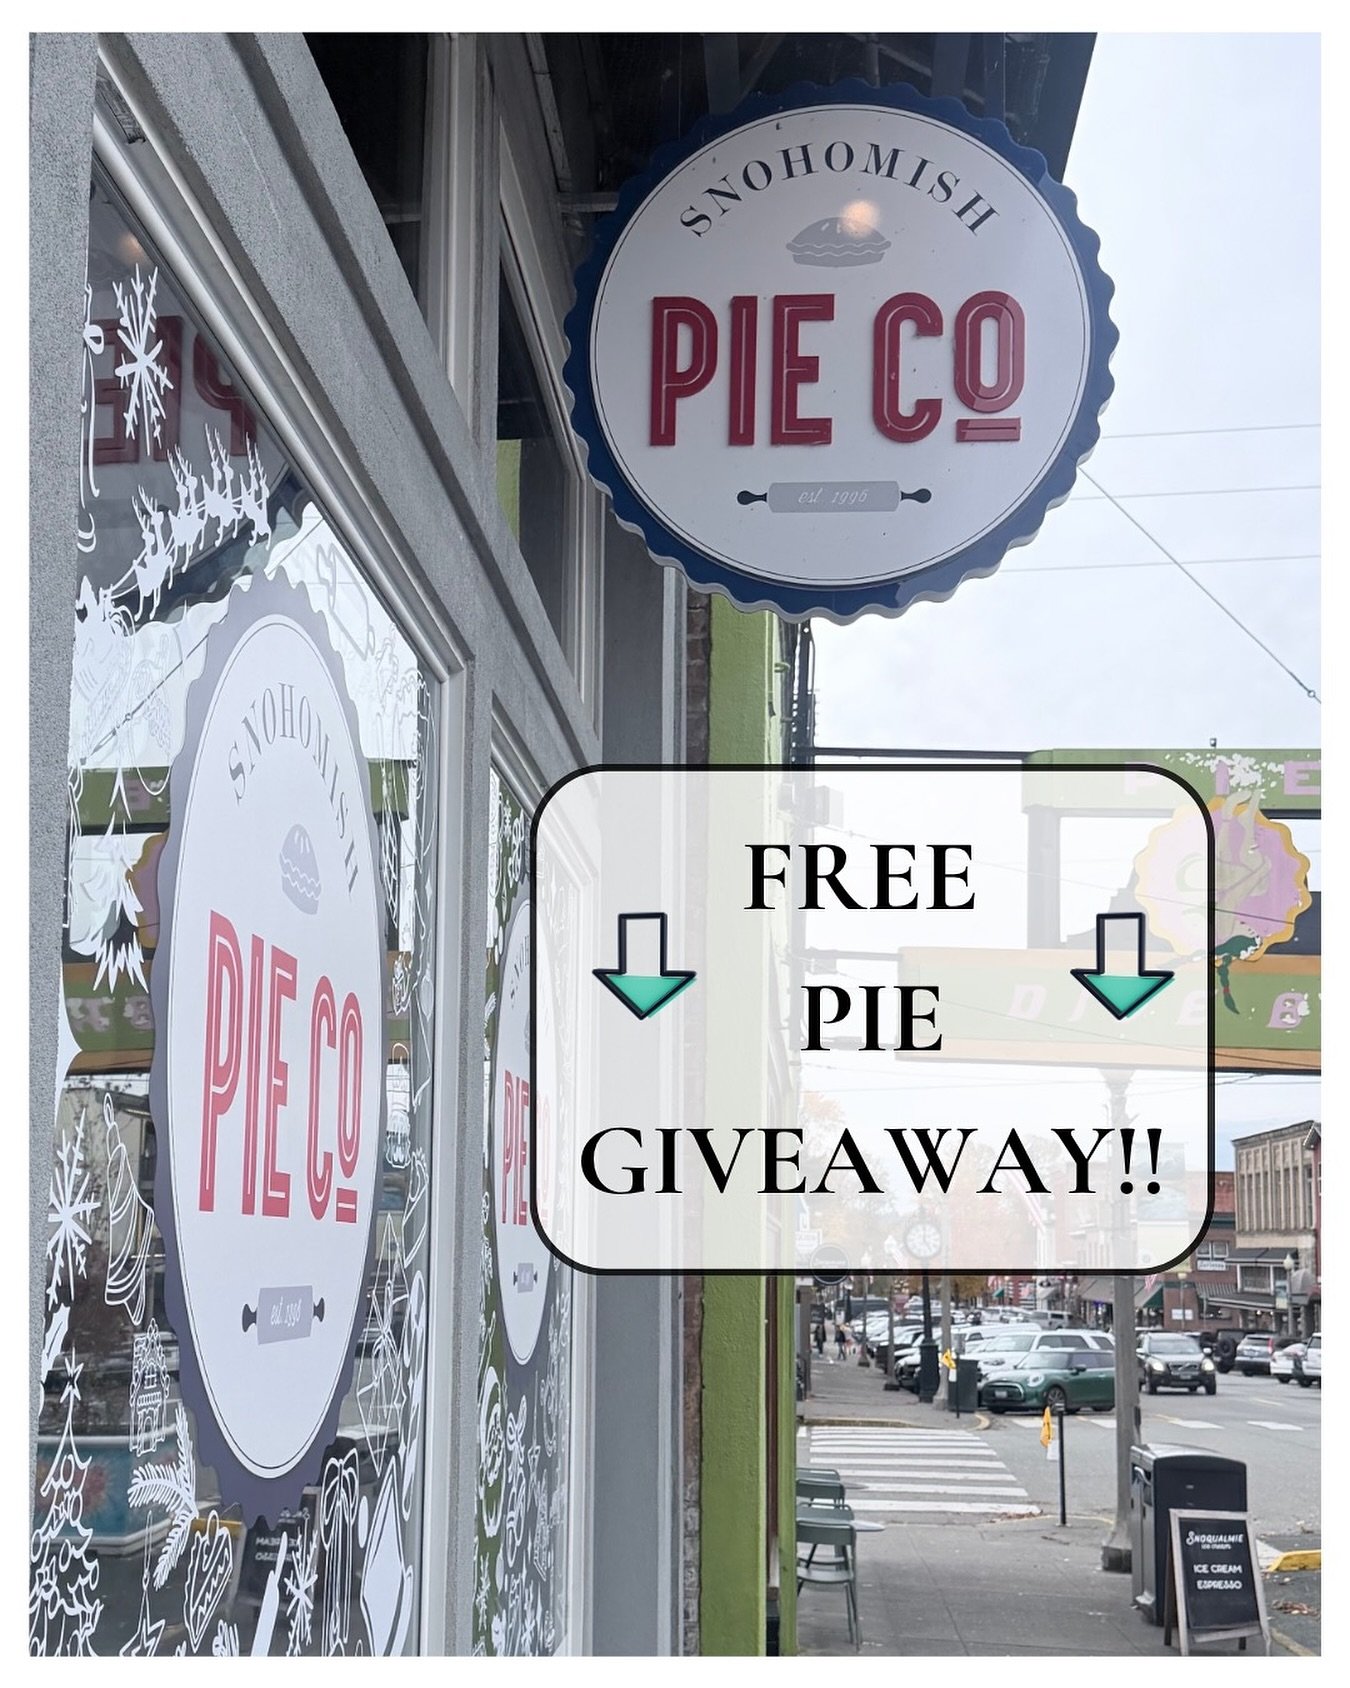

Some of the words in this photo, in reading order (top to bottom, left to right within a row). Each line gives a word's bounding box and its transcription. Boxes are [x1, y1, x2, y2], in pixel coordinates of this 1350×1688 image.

[679, 140, 1001, 239] SNOHOMISH
[649, 293, 836, 446] PIE
[831, 488, 869, 505] 1996
[227, 682, 360, 897] SNOHOMISH
[199, 911, 298, 1218] PIE
[1193, 1564, 1209, 1574] ICE
[1210, 1564, 1243, 1574] CREAM
[1196, 1579, 1243, 1590] ESPRESSO
